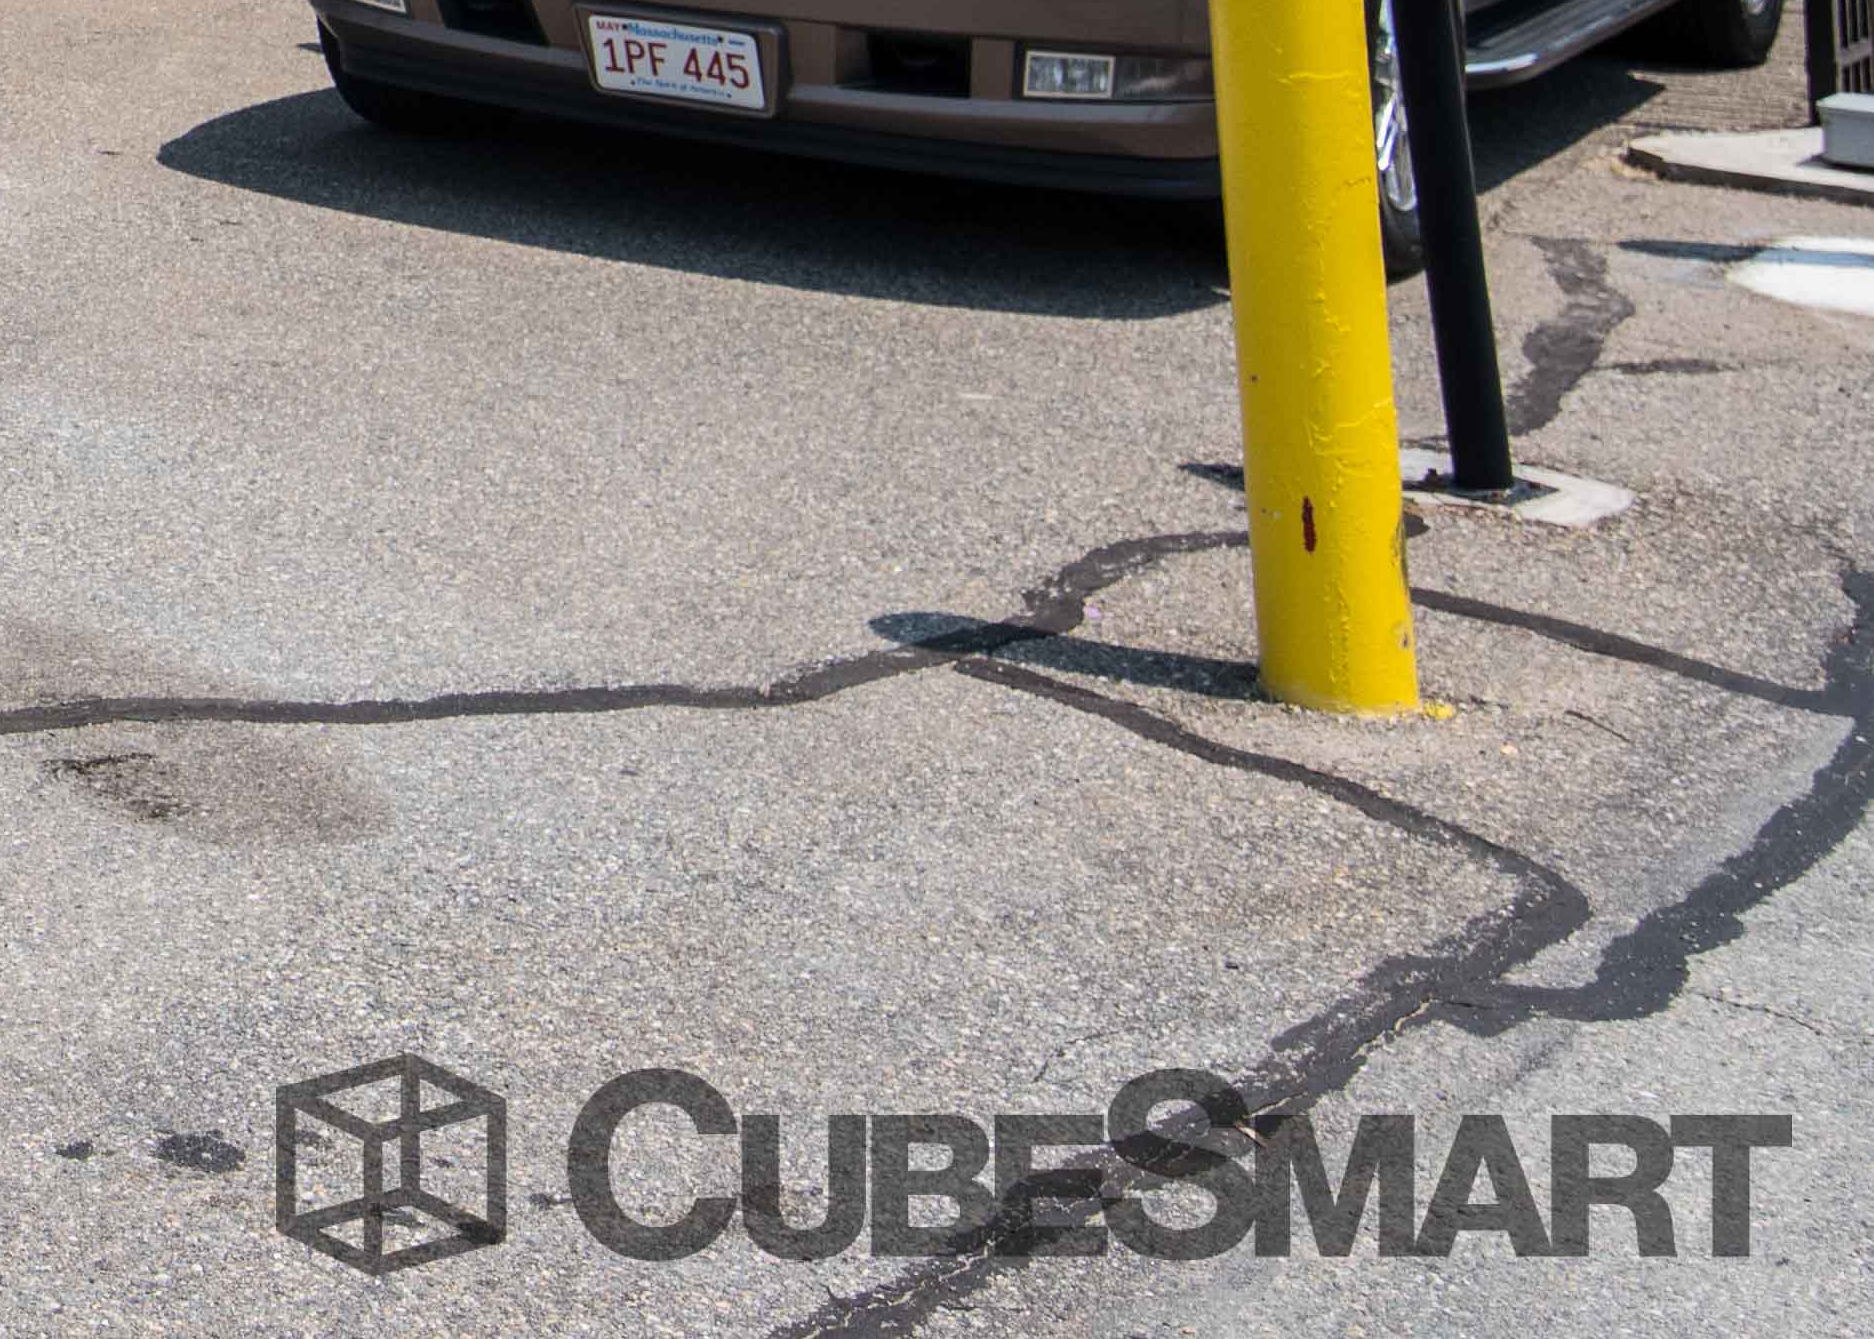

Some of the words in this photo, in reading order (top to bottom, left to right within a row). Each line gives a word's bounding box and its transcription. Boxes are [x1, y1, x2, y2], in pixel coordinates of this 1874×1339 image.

[596, 20, 620, 30] MAY
[628, 22, 718, 45] Massachusetts
[603, 38, 667, 76] 1PF
[683, 48, 750, 89] 445
